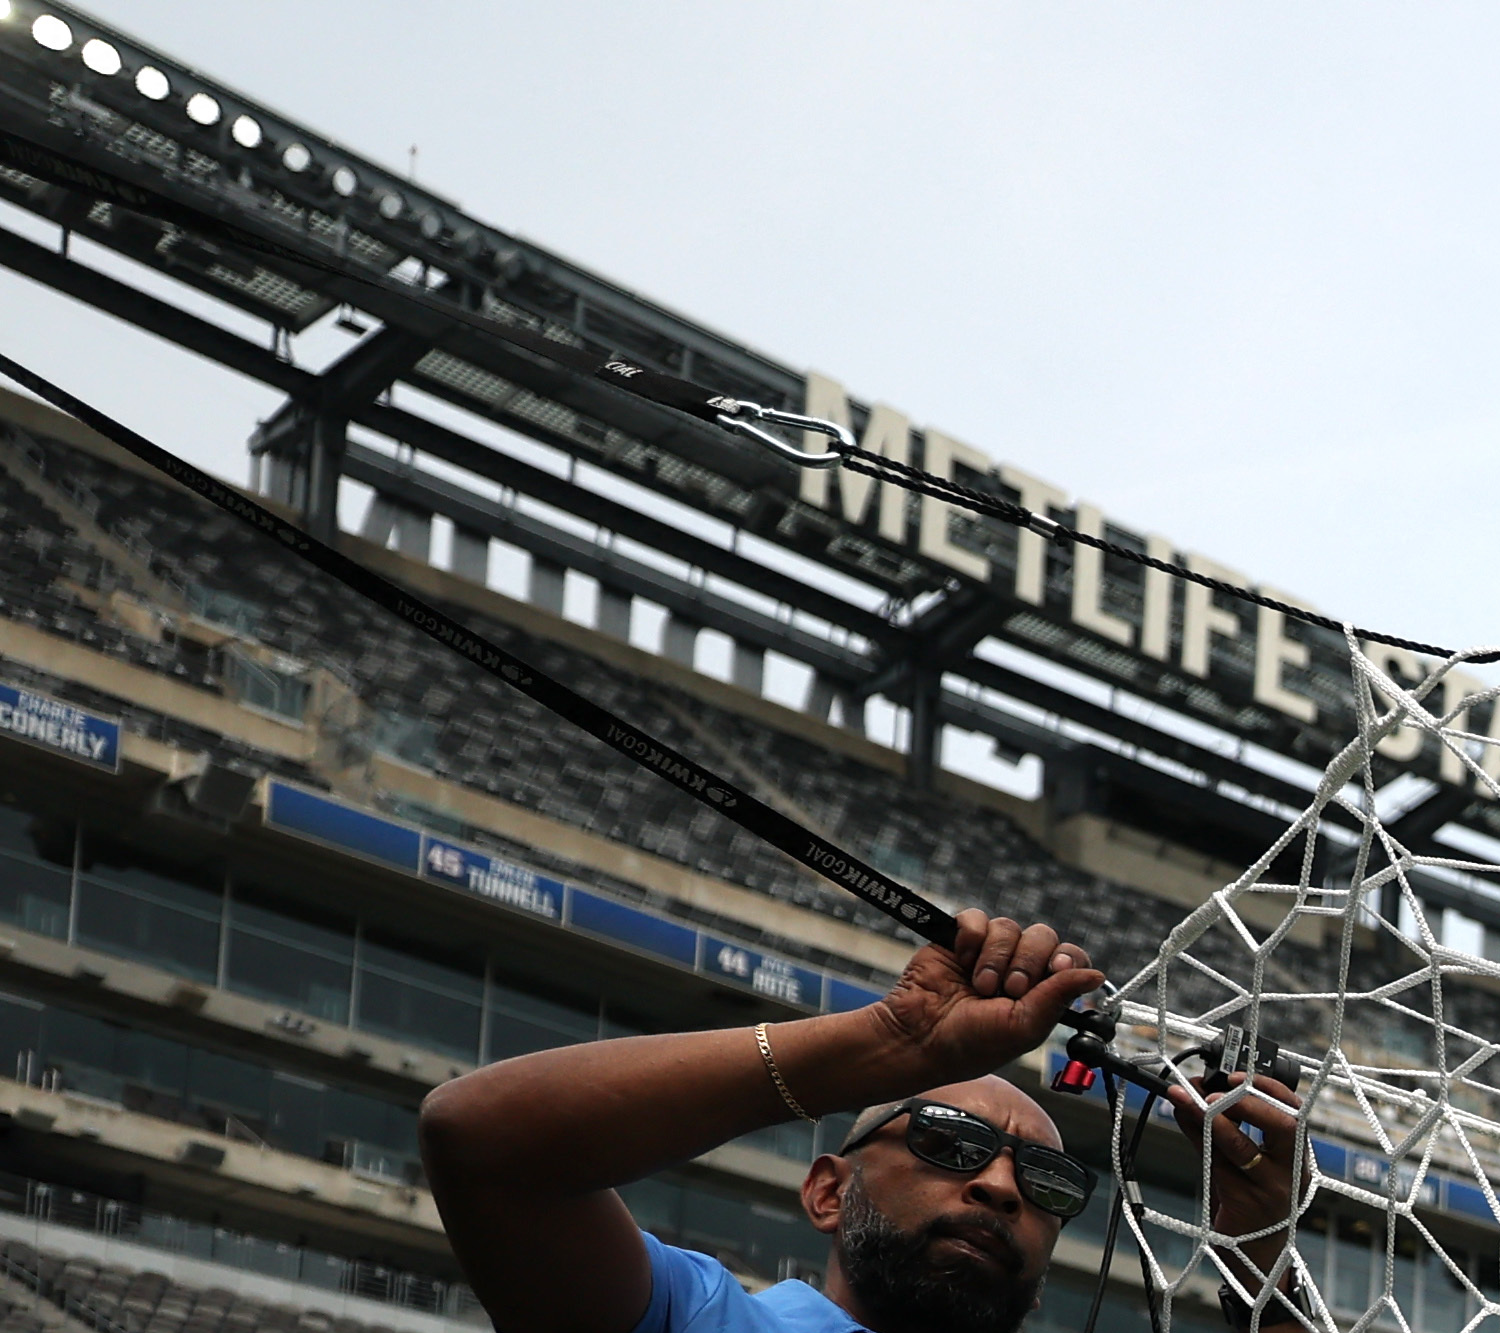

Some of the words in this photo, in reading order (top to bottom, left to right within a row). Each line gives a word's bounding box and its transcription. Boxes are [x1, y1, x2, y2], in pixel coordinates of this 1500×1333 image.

[800, 368, 1323, 724] METLIFE
[605, 722, 708, 793] KWIKGOAL
[428, 844, 464, 878] 45
[468, 865, 557, 918] TUNNELL
[806, 840, 903, 910] KWIKGOAL
[717, 946, 750, 977] 44
